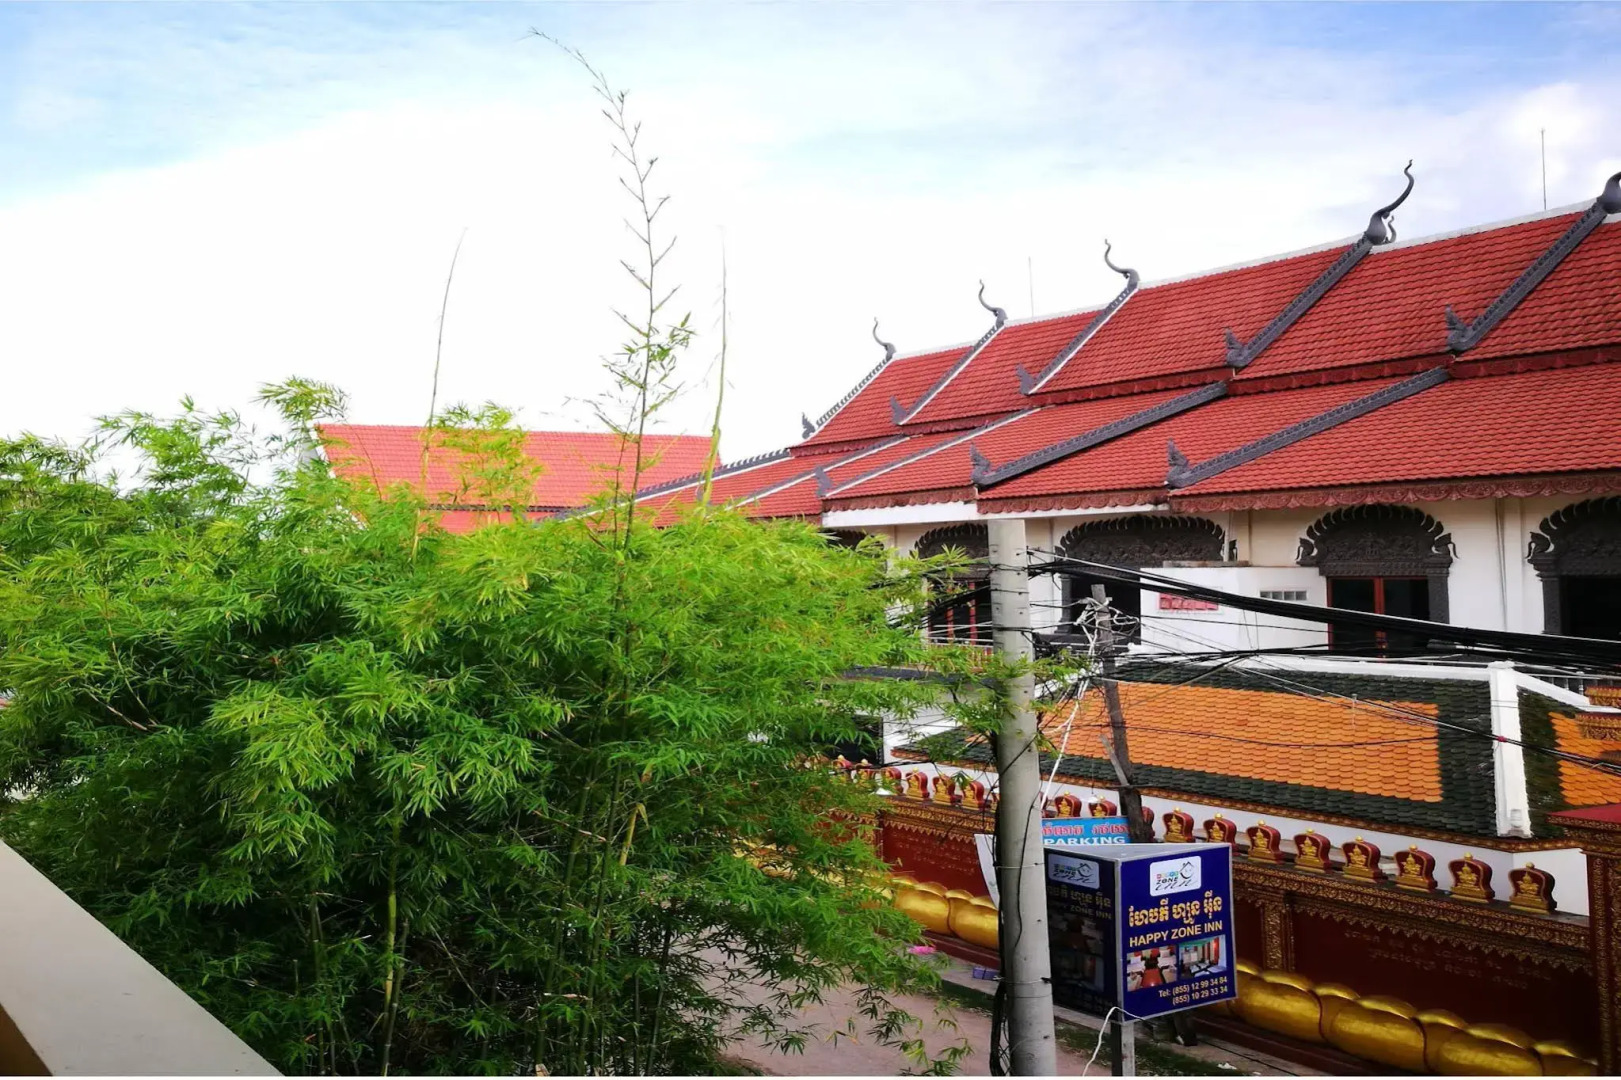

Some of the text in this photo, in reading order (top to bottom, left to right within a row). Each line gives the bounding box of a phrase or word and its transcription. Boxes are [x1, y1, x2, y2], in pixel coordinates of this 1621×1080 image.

[1043, 836, 1126, 846] PARKING
[1129, 920, 1223, 948] HAPPY ZONE INN
[1158, 988, 1171, 998] Tel:
[1172, 984, 1190, 996] (855)
[1191, 982, 1200, 991] 12
[1200, 979, 1209, 988] 99
[1210, 977, 1218, 986] 34
[1172, 994, 1190, 1006] (855)
[1191, 991, 1200, 1000] 10
[1210, 987, 1219, 996] 33
